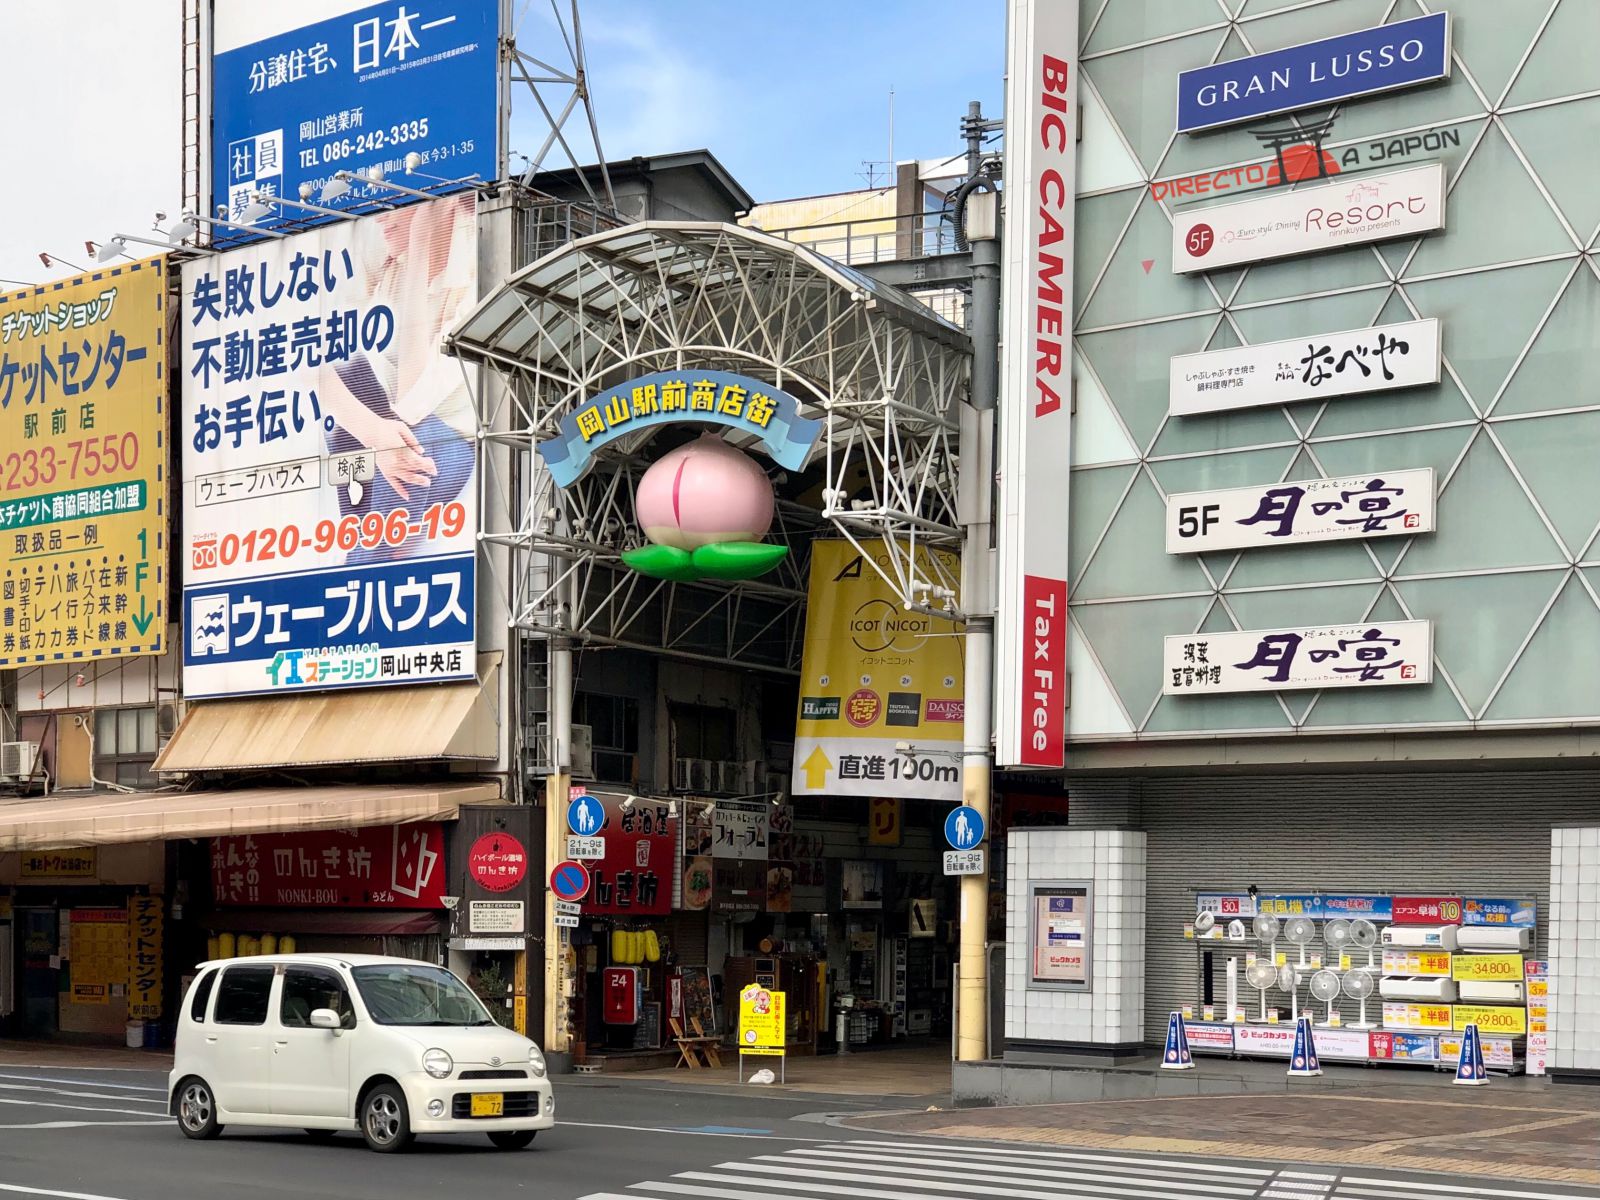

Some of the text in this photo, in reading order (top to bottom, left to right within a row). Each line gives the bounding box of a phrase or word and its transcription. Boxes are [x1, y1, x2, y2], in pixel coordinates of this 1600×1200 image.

[353, 6, 456, 73] 日本一
[249, 42, 337, 94] 分譲住宅、
[1197, 39, 1424, 107] GRAN LUSSO
[299, 118, 429, 169] TEL 086-242-3335
[300, 107, 363, 142] 岡山営業所
[231, 139, 277, 181] 社員
[1237, 220, 1301, 238] Euro style Dining
[1305, 197, 1426, 232] Resort
[1328, 218, 1401, 238] ninnikuya presents
[1035, 54, 1068, 418] BIC CAMERA
[1189, 230, 1211, 251] 5F
[192, 247, 354, 328] 失敗しない
[2, 289, 118, 344] チケットショップ
[191, 304, 395, 390] 不動産売却の
[1301, 333, 1409, 386] なべや
[24, 402, 95, 440] 駅前店
[192, 388, 335, 454] お手伝い。
[576, 378, 778, 443] 岡山駅前商店街
[6, 431, 140, 491] 233-7550
[337, 454, 366, 478] 検索
[200, 464, 305, 501] ウェーブハウス
[1178, 505, 1220, 538] 5F
[1233, 478, 1408, 537] 月の宴
[15, 524, 98, 554] 取扱品一例
[219, 502, 466, 566] 0120-9696-19
[3, 580, 15, 653] 図書券
[35, 577, 46, 649] テレカ
[50, 575, 62, 648] ハイカ
[66, 573, 78, 647] 旅行券
[99, 568, 111, 642] 在来線
[115, 566, 128, 641] 新幹線
[232, 571, 467, 648] ウェーブハウス
[851, 620, 928, 632] ICOT NICOT
[381, 650, 462, 677] 岡山中央店
[860, 657, 915, 665] イコットニコット
[1032, 593, 1055, 751] Tax Free
[1232, 628, 1404, 682] 月の宴
[851, 705, 876, 713] ラーメン
[838, 755, 959, 782] 直進100m
[273, 846, 372, 880] のんき坊
[473, 854, 523, 863] ハイボール酒場
[477, 866, 519, 876] のんき坊
[946, 862, 981, 872] 自転車を除く
[1260, 899, 1303, 914] 扇風機
[136, 900, 157, 1002] チケットセンター
[1050, 956, 1081, 964] ビックカメラ
[1426, 957, 1449, 970] 半額
[611, 974, 627, 988] 24
[1250, 1031, 1288, 1039] ビックカメラ
[1427, 1010, 1449, 1023] 半額
[491, 1102, 501, 1114] 72
